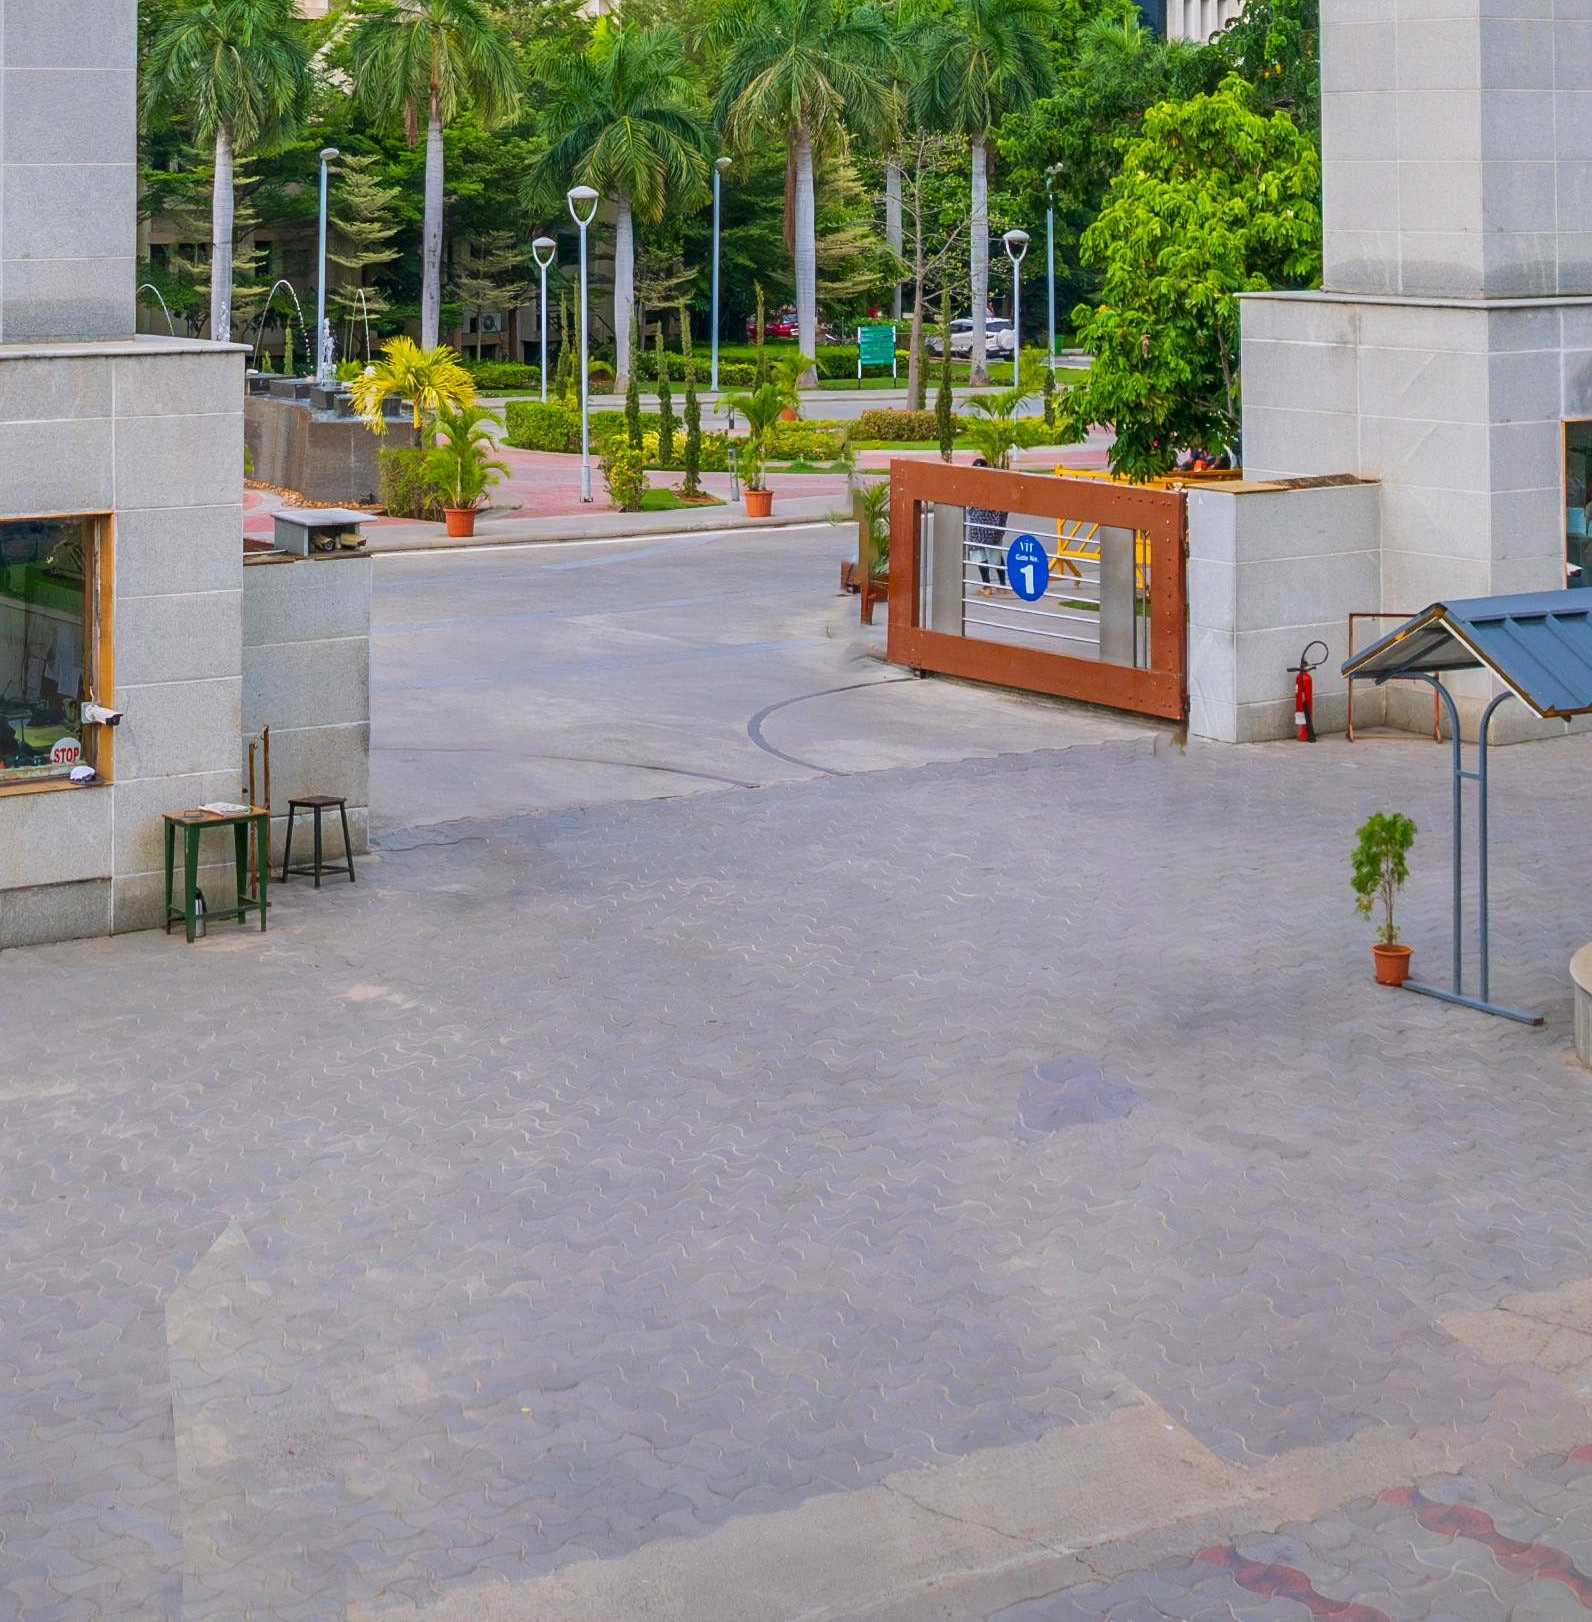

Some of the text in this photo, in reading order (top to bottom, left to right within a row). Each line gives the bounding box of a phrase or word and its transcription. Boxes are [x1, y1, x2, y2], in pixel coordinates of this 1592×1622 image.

[1020, 540, 1034, 552] VIT
[1020, 564, 1034, 594] 1
[53, 746, 79, 763] STOP
